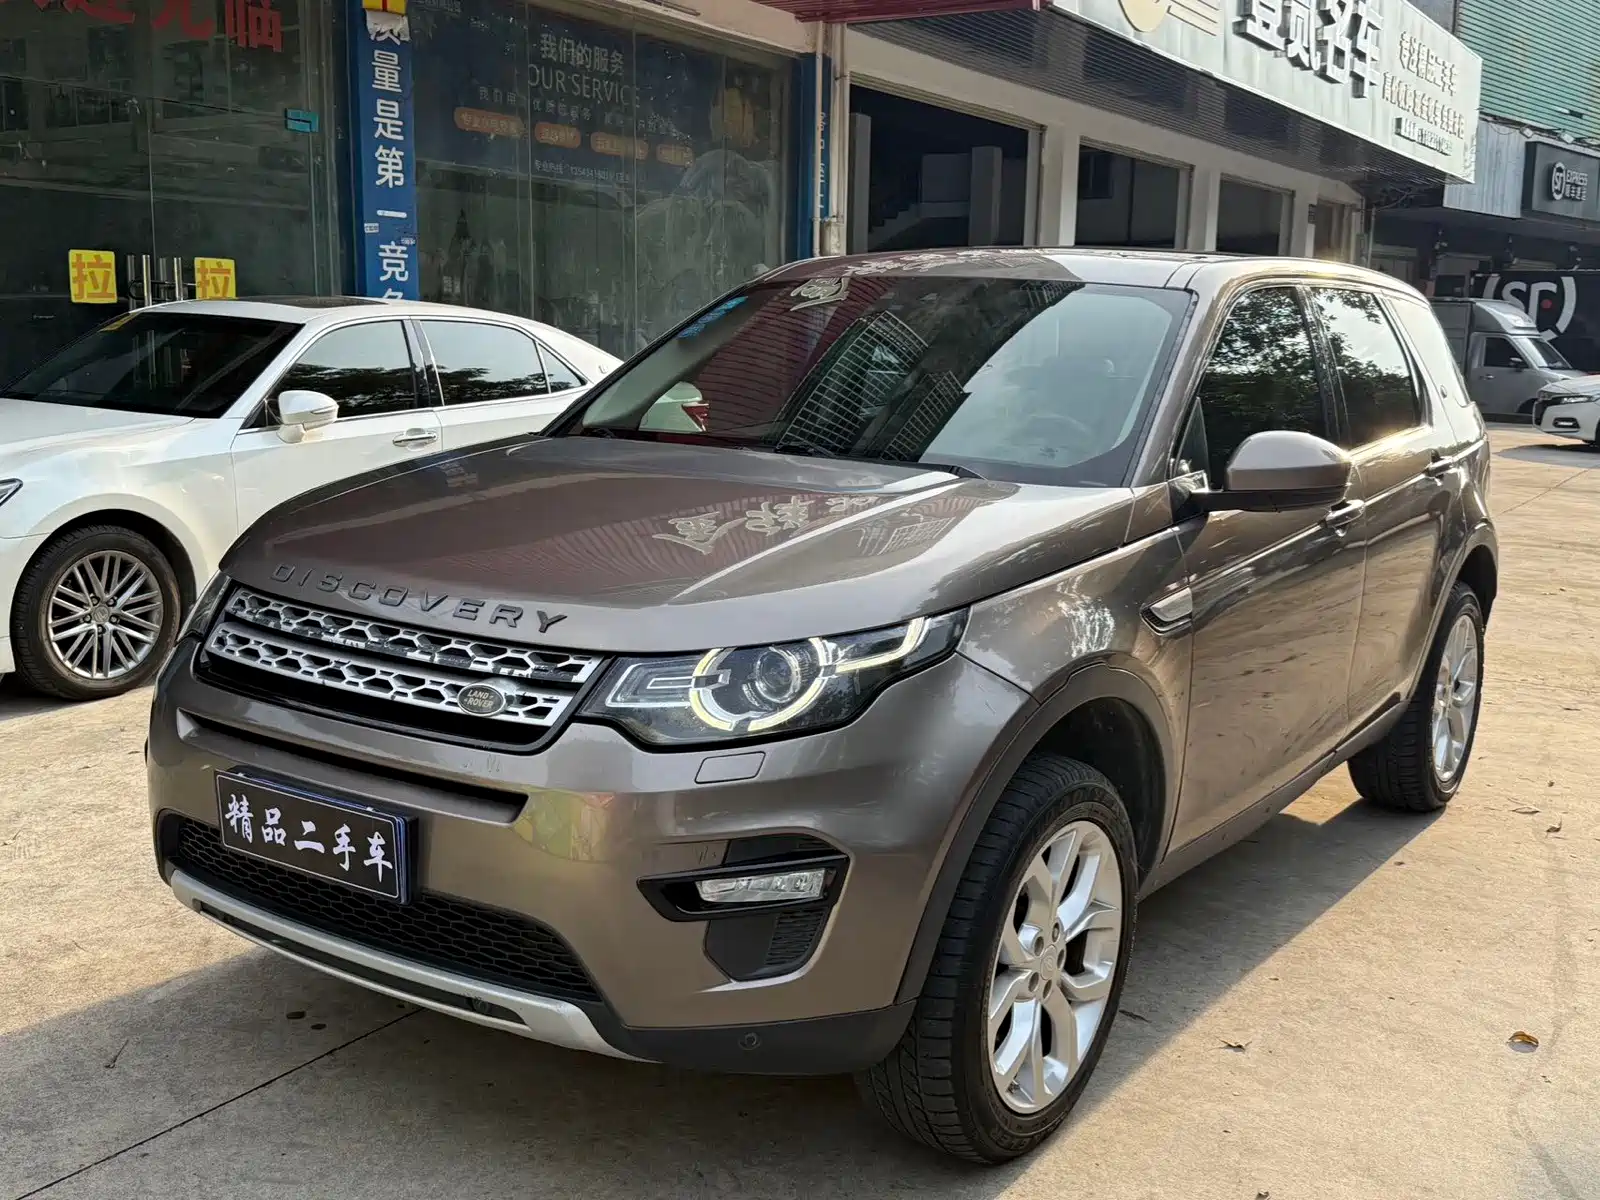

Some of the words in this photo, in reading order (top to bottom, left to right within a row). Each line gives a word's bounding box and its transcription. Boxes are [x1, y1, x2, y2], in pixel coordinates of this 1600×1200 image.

[540, 34, 624, 76] 我们的服务
[528, 63, 567, 93] OUR
[72, 253, 115, 299] 拉
[197, 260, 231, 299] 拉
[270, 563, 568, 633] DISCOVERY
[467, 690, 490, 700] LAND
[467, 697, 494, 708] ROVER
[225, 794, 393, 882] 精品二手车
